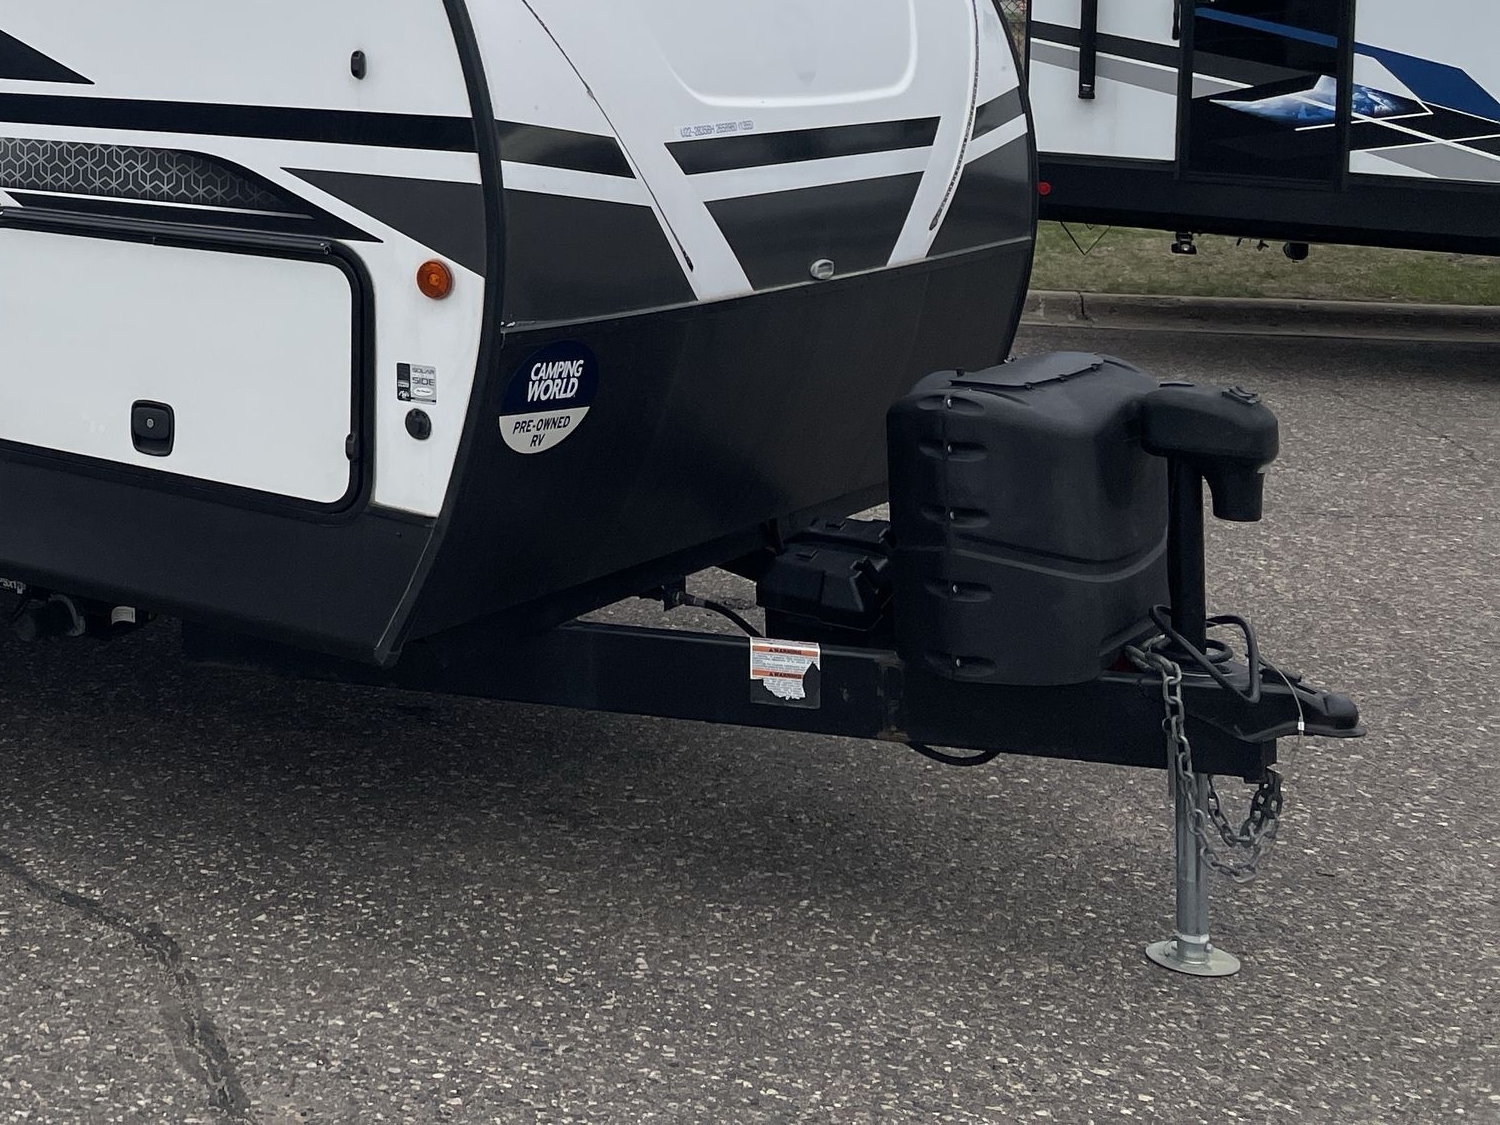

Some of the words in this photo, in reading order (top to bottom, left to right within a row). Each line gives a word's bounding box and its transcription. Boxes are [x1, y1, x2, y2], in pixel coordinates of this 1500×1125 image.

[530, 360, 584, 381] CAMPING
[412, 376, 435, 386] SIDE
[527, 378, 578, 402] WORLD
[512, 416, 571, 434] PRE-OWNED
[530, 433, 546, 447] RV
